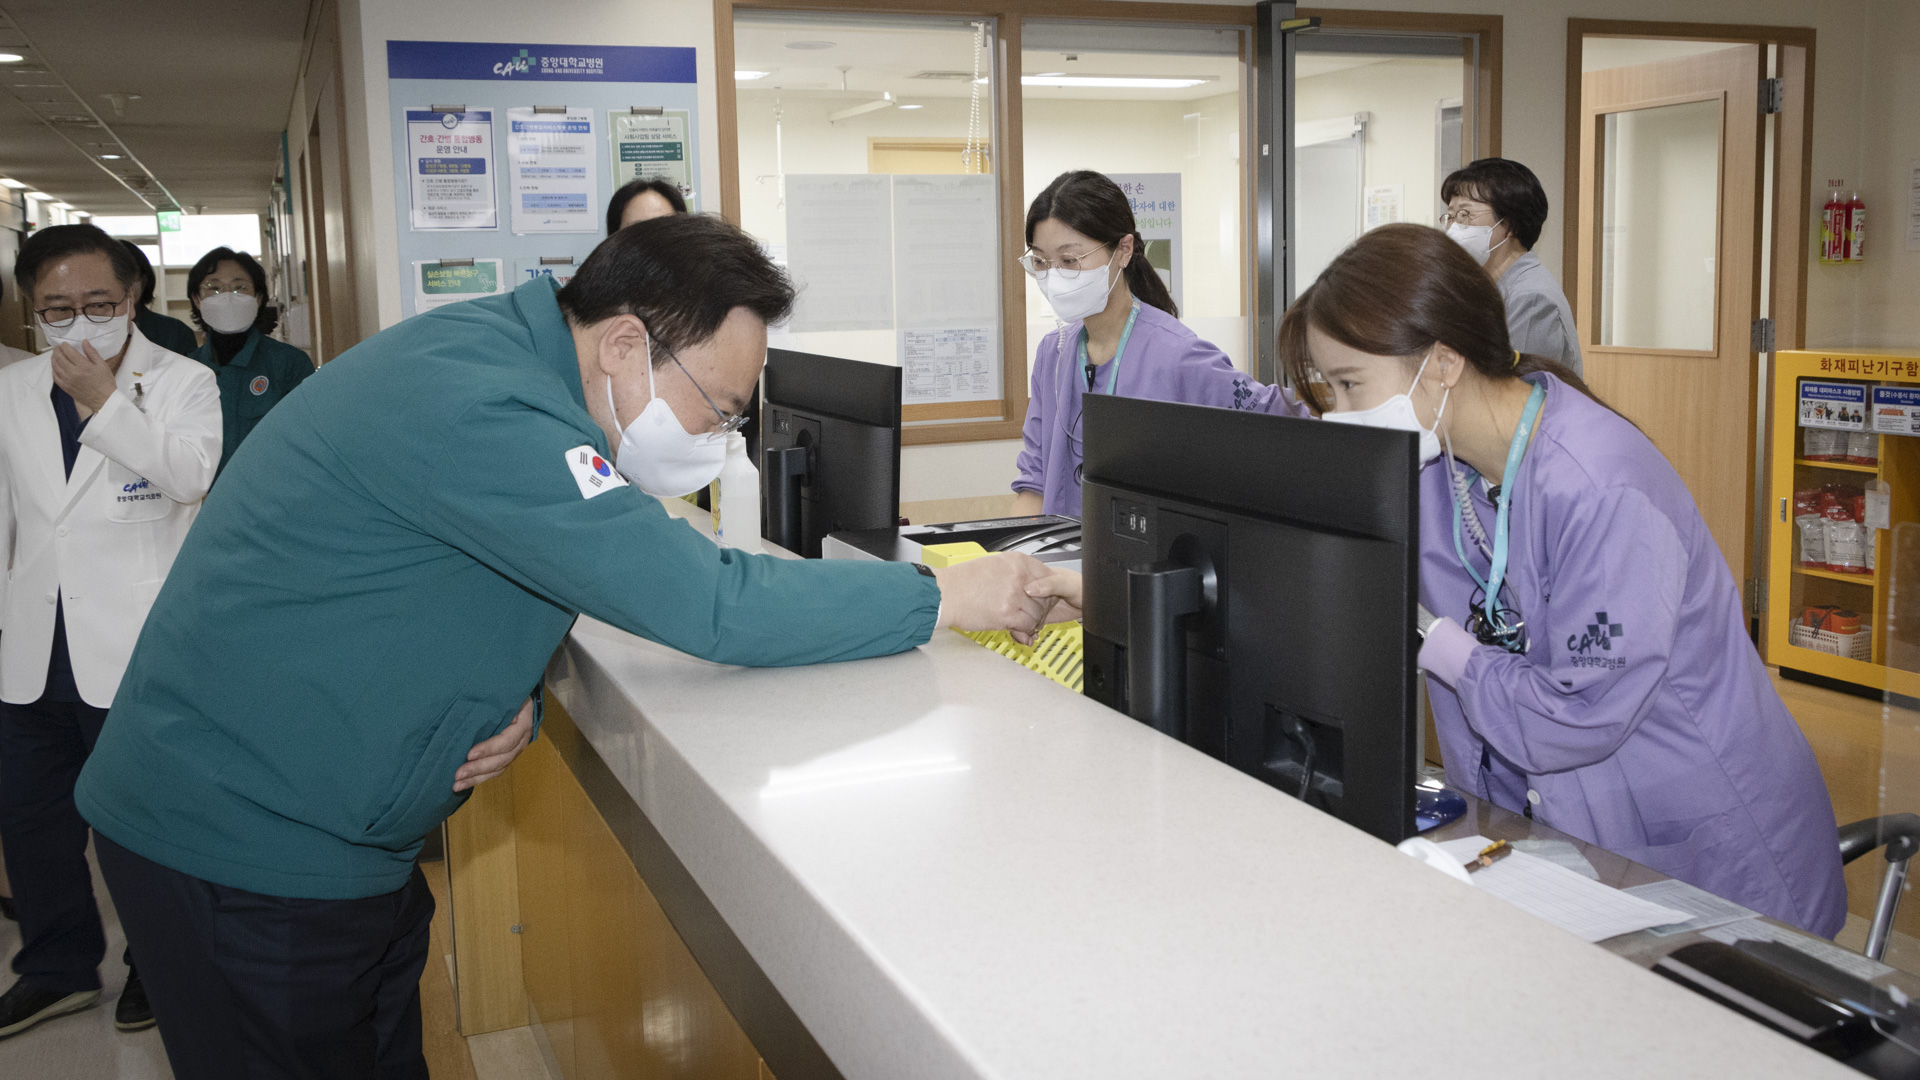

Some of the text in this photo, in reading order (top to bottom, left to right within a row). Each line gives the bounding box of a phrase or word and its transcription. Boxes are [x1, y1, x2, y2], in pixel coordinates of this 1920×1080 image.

[541, 57, 603, 69] 중앙대학교병원
[454, 135, 483, 144] 통합병동
[436, 145, 468, 154] 운영 안내
[1135, 182, 1145, 194] 손
[1159, 201, 1175, 211] 대한
[427, 268, 479, 279] 실손보험 빠른청구
[427, 279, 461, 288] 서비스 안내
[1821, 358, 1919, 376] 화재피난기구함
[1819, 387, 1842, 395] 대피마스크
[1842, 388, 1861, 396] 사용방법
[117, 493, 161, 502] 중앙대학교의료원
[1568, 631, 1606, 654] CAU
[1571, 656, 1626, 670] 중앙대학교병원
